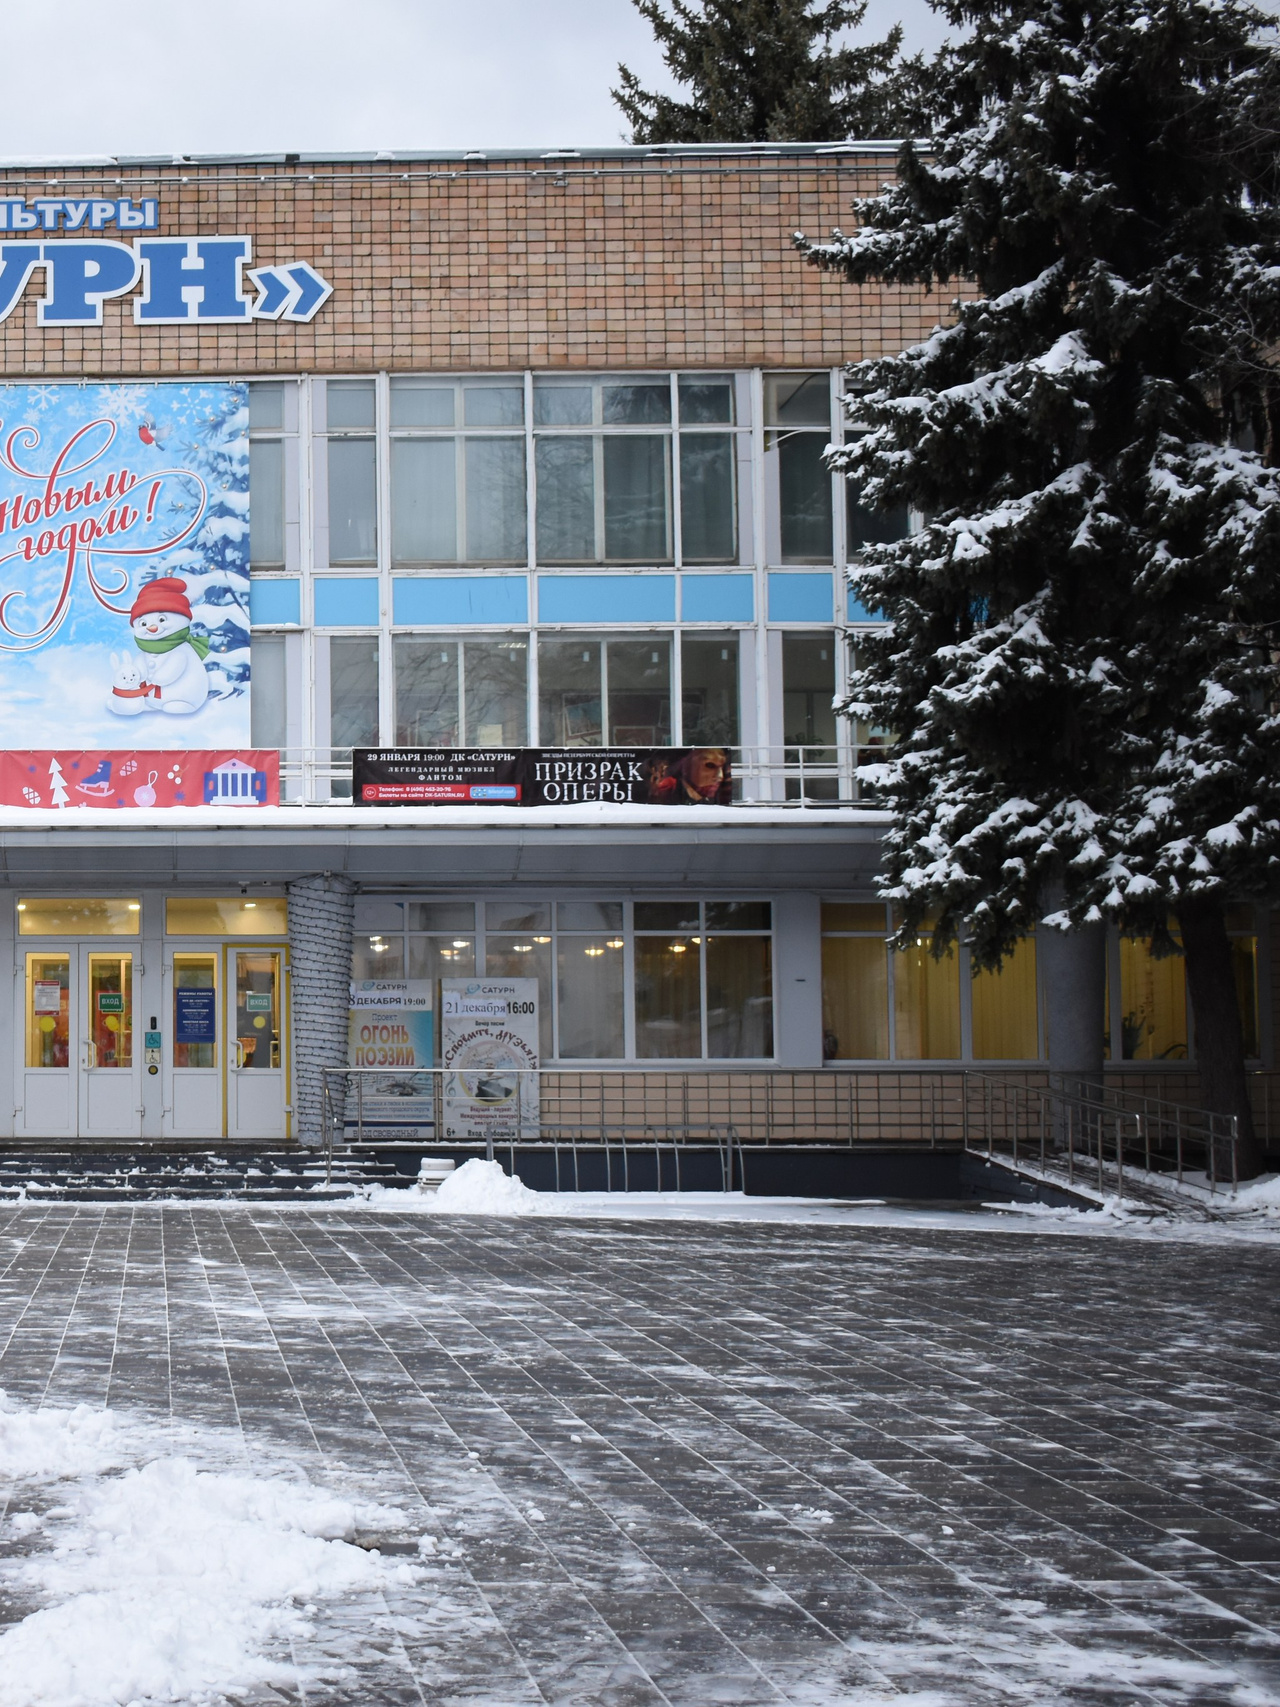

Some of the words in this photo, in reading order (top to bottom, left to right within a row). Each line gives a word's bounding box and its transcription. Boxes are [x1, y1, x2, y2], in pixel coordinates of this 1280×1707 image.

[367, 753, 378, 761] 29
[380, 753, 420, 761] ЯНВАРЯ
[423, 753, 445, 761] 19:00
[450, 753, 465, 762] ДК
[466, 753, 516, 761] «САТУРН»
[388, 765, 454, 773] ЛЕГЕНДАРНЫЙ
[534, 761, 644, 781] ПРИЗРАК
[543, 782, 633, 801] ОПЕРЫ
[356, 997, 402, 1006] ДЕКАБРЯ
[403, 998, 426, 1006] 19:00
[445, 1001, 459, 1013] 21
[461, 1002, 506, 1016] декабря
[507, 1001, 535, 1014] 16:00
[372, 1013, 398, 1023] Проект
[361, 1025, 409, 1044] ОГОНЬ
[355, 1046, 415, 1066] ПОЭЗИИ
[352, 1129, 373, 1138] ВОД
[373, 1128, 419, 1138] СВОБОДНЫЙ
[446, 1127, 456, 1137] 6+
[467, 1129, 482, 1137] Вход
[483, 1129, 516, 1137] сободный
